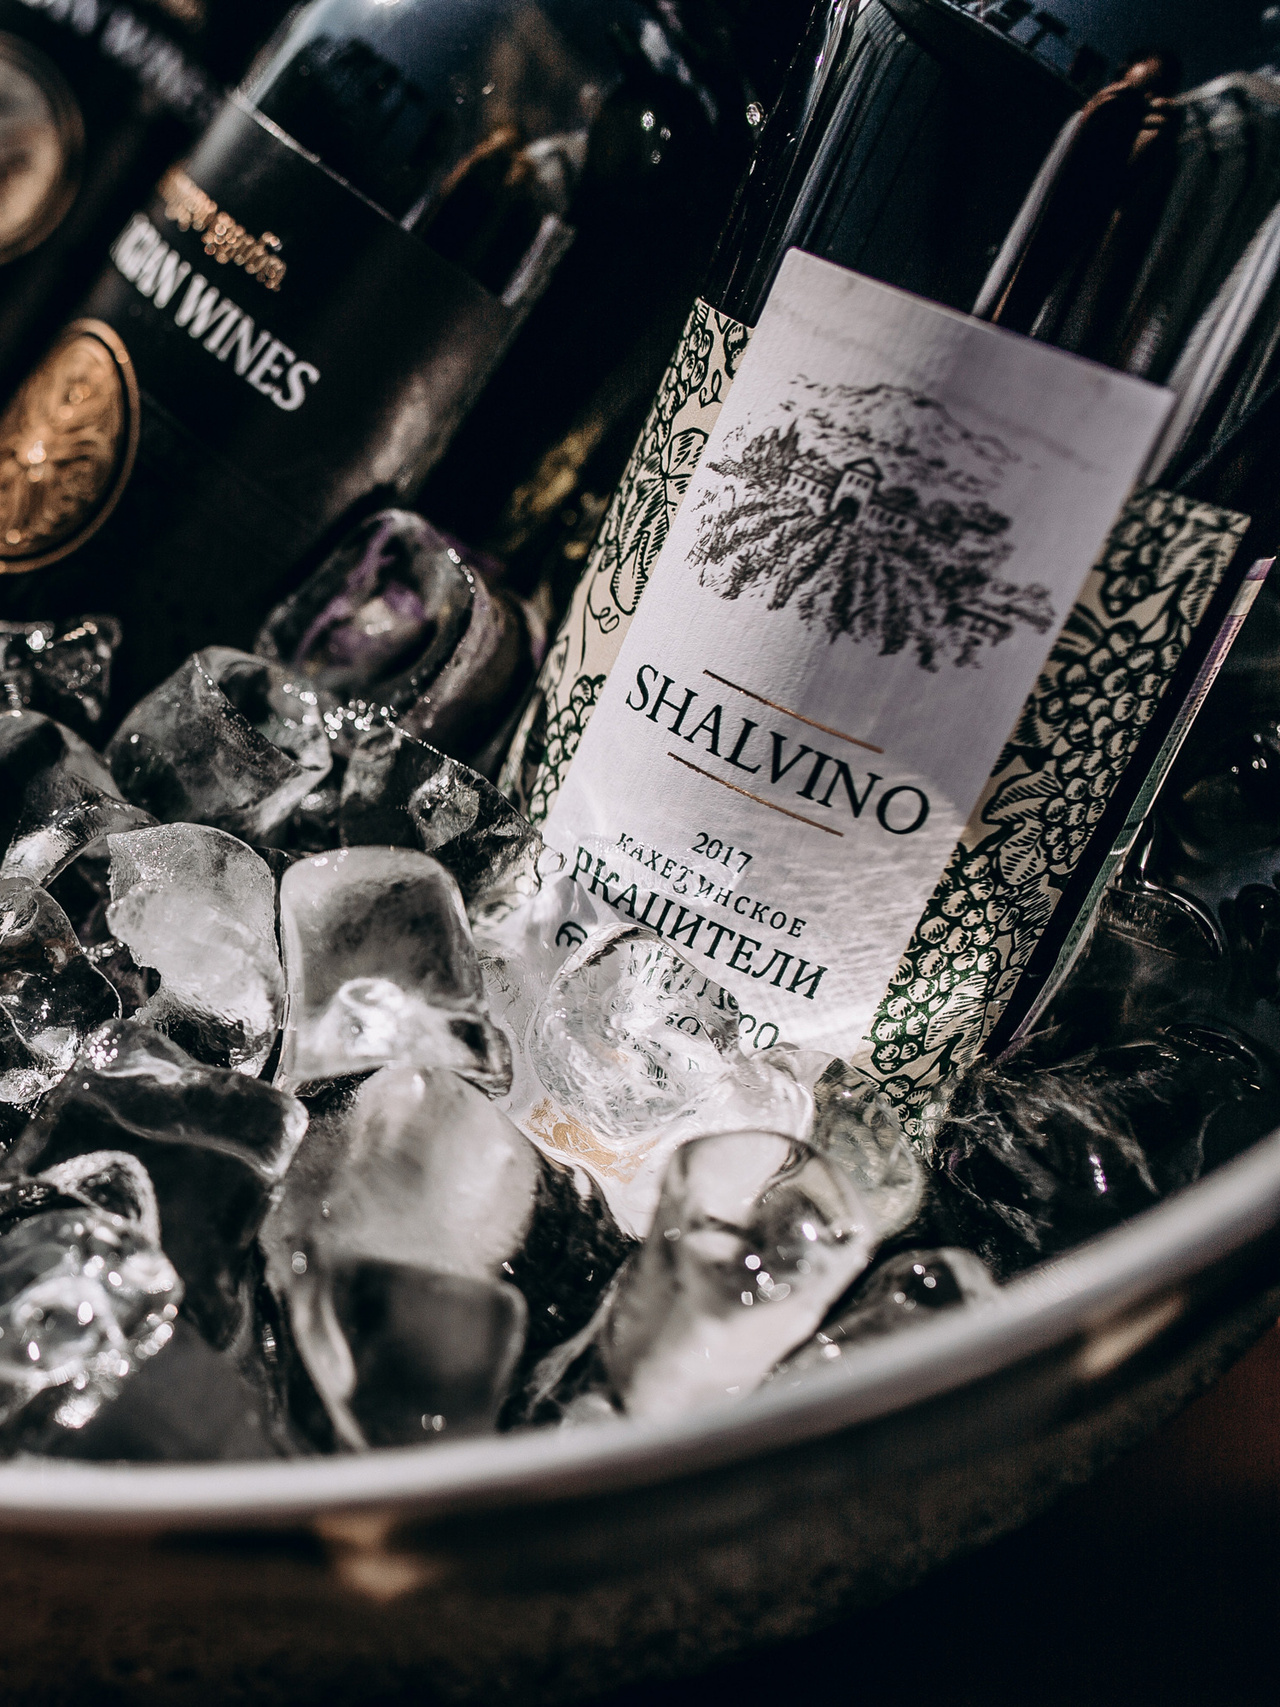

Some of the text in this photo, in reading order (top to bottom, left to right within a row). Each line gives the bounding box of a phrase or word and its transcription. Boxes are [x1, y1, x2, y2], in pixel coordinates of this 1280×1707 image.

[174, 273, 320, 411] WINES
[625, 664, 931, 835] SHALVINO
[616, 832, 807, 939] КАХЕТИНСКОЕ
[691, 832, 754, 873] 2017
[570, 846, 829, 1000] РКАЦИТЕЛИ
